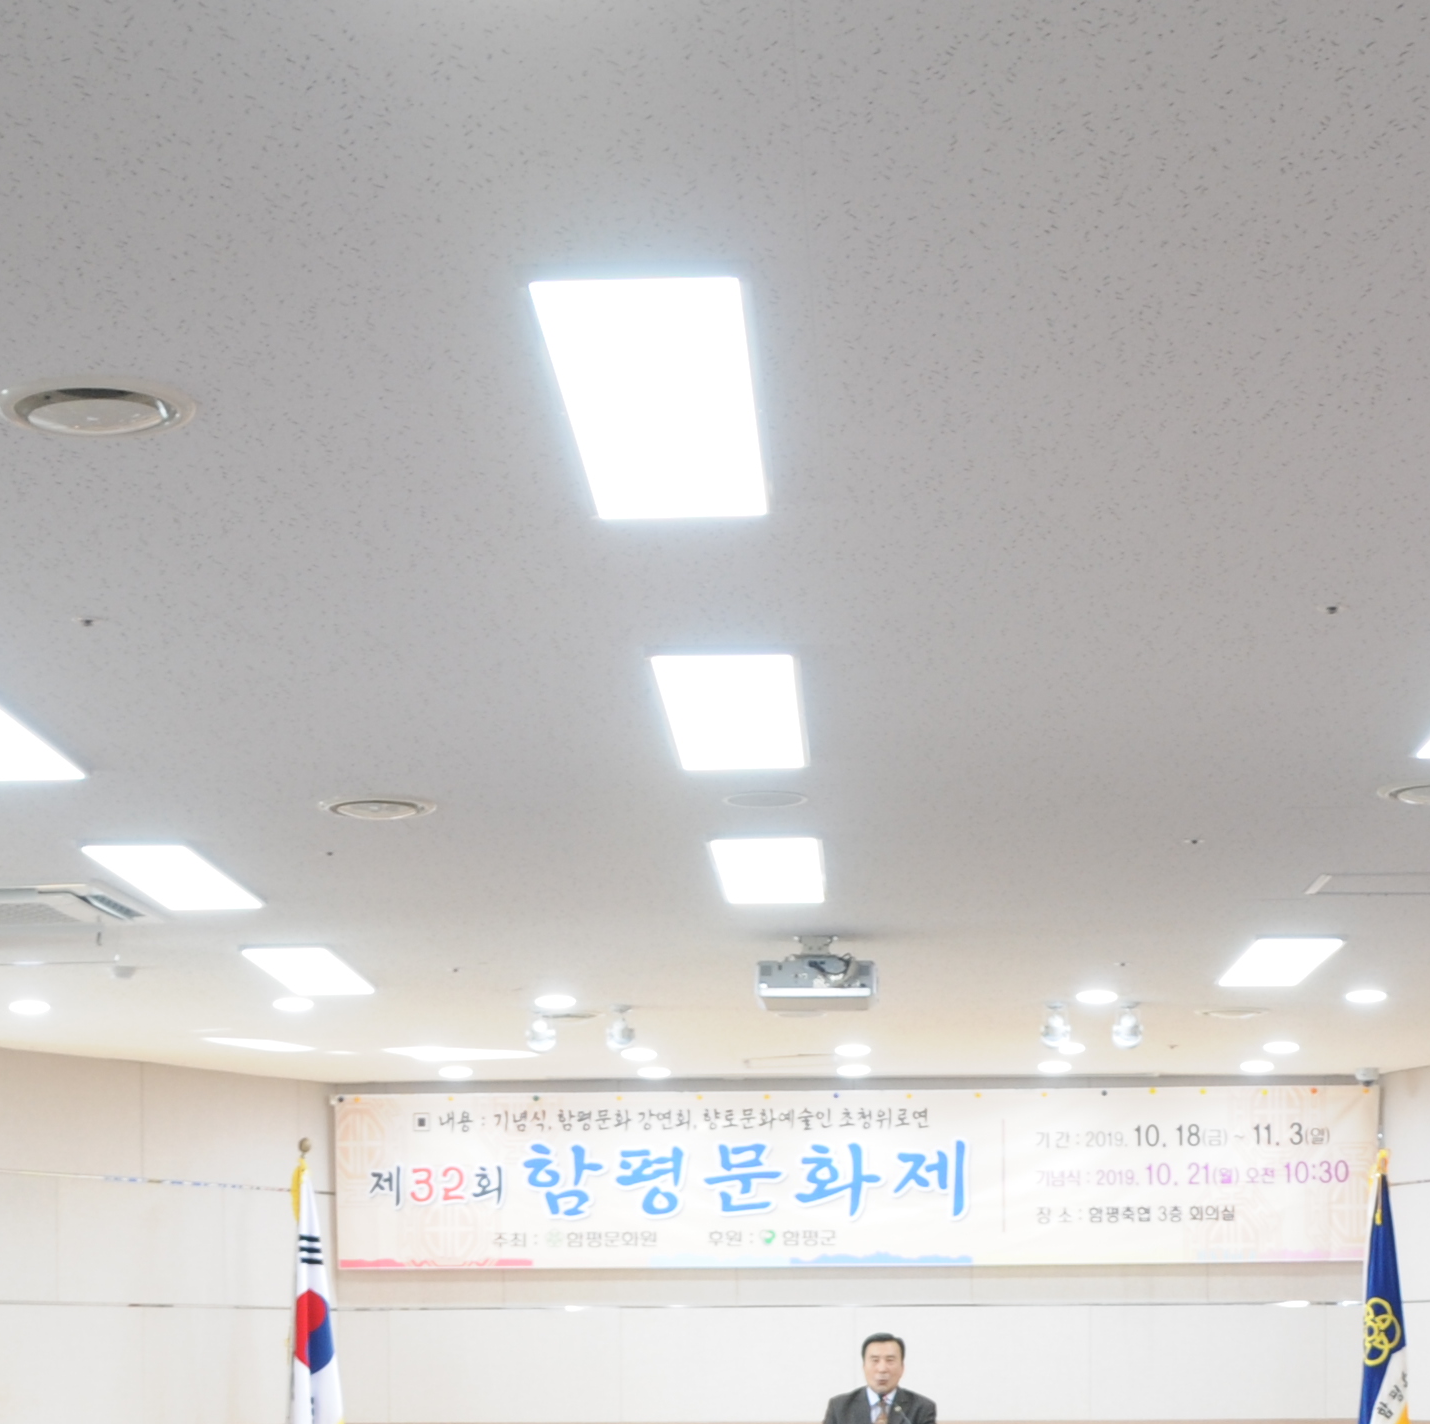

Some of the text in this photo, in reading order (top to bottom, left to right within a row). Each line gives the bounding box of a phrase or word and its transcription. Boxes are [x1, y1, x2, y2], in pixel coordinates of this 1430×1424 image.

[438, 1110, 474, 1133] 내용
[557, 1109, 632, 1132] 함평문화
[703, 1107, 832, 1131] 향토문화예술인
[839, 1107, 929, 1130] 초청위로연
[1133, 1123, 1167, 1148] 10.
[523, 1141, 967, 1217] 함평문화제
[1036, 1170, 1080, 1187] 기념식
[1145, 1162, 1179, 1187] 10.
[1245, 1166, 1277, 1185] 오전
[1283, 1159, 1351, 1185] 10:30
[1157, 1205, 1183, 1223] 3층
[1189, 1204, 1236, 1223] 회의실
[491, 1231, 528, 1248] 주최
[566, 1230, 658, 1249] 함평문화원
[708, 1230, 743, 1247] 후원
[782, 1229, 837, 1247] 함평군
